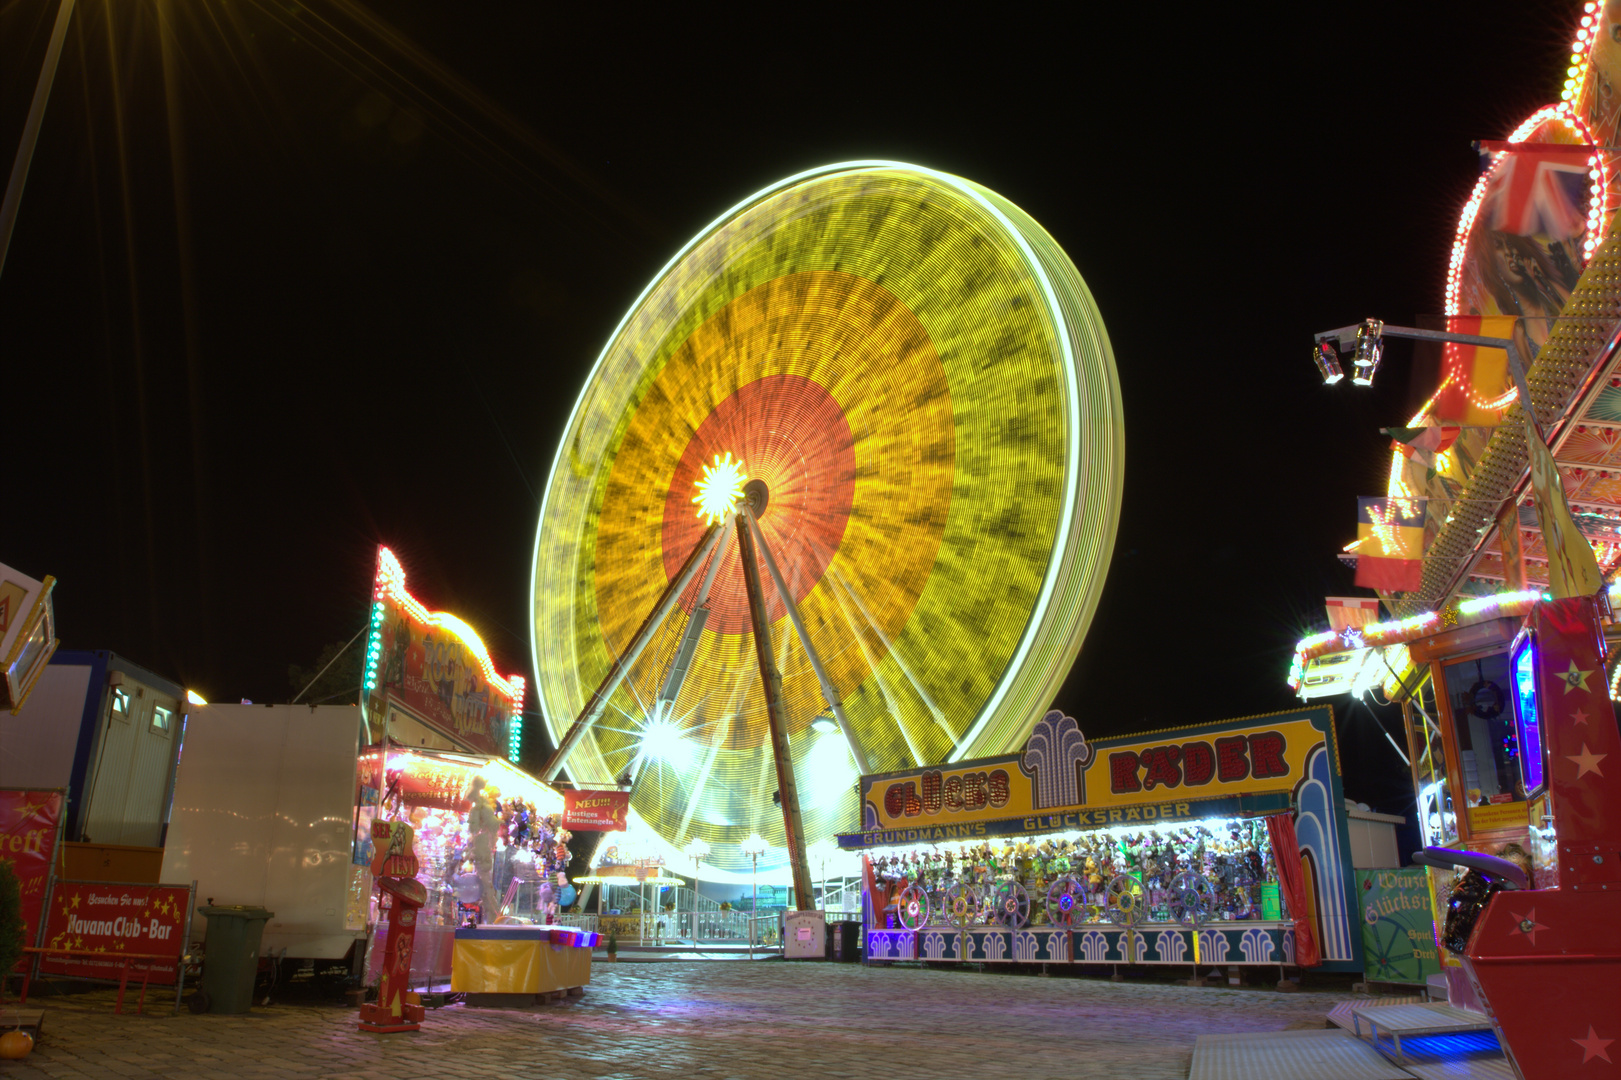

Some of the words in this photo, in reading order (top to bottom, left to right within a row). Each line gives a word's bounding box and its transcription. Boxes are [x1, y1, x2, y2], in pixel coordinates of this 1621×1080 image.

[1108, 730, 1290, 794] RÄDER
[575, 798, 611, 809] NEU!!!
[566, 817, 614, 826] Entenangeln
[567, 810, 598, 819] Lustiges
[863, 823, 986, 845] GRUNDMANN'S
[1023, 803, 1191, 831] GLÜCKSRÄDER
[390, 855, 415, 876] TEST
[87, 893, 118, 906] Besuchen
[120, 893, 131, 906] Sie
[132, 896, 149, 907] uns!
[1365, 891, 1432, 925] Glücksr
